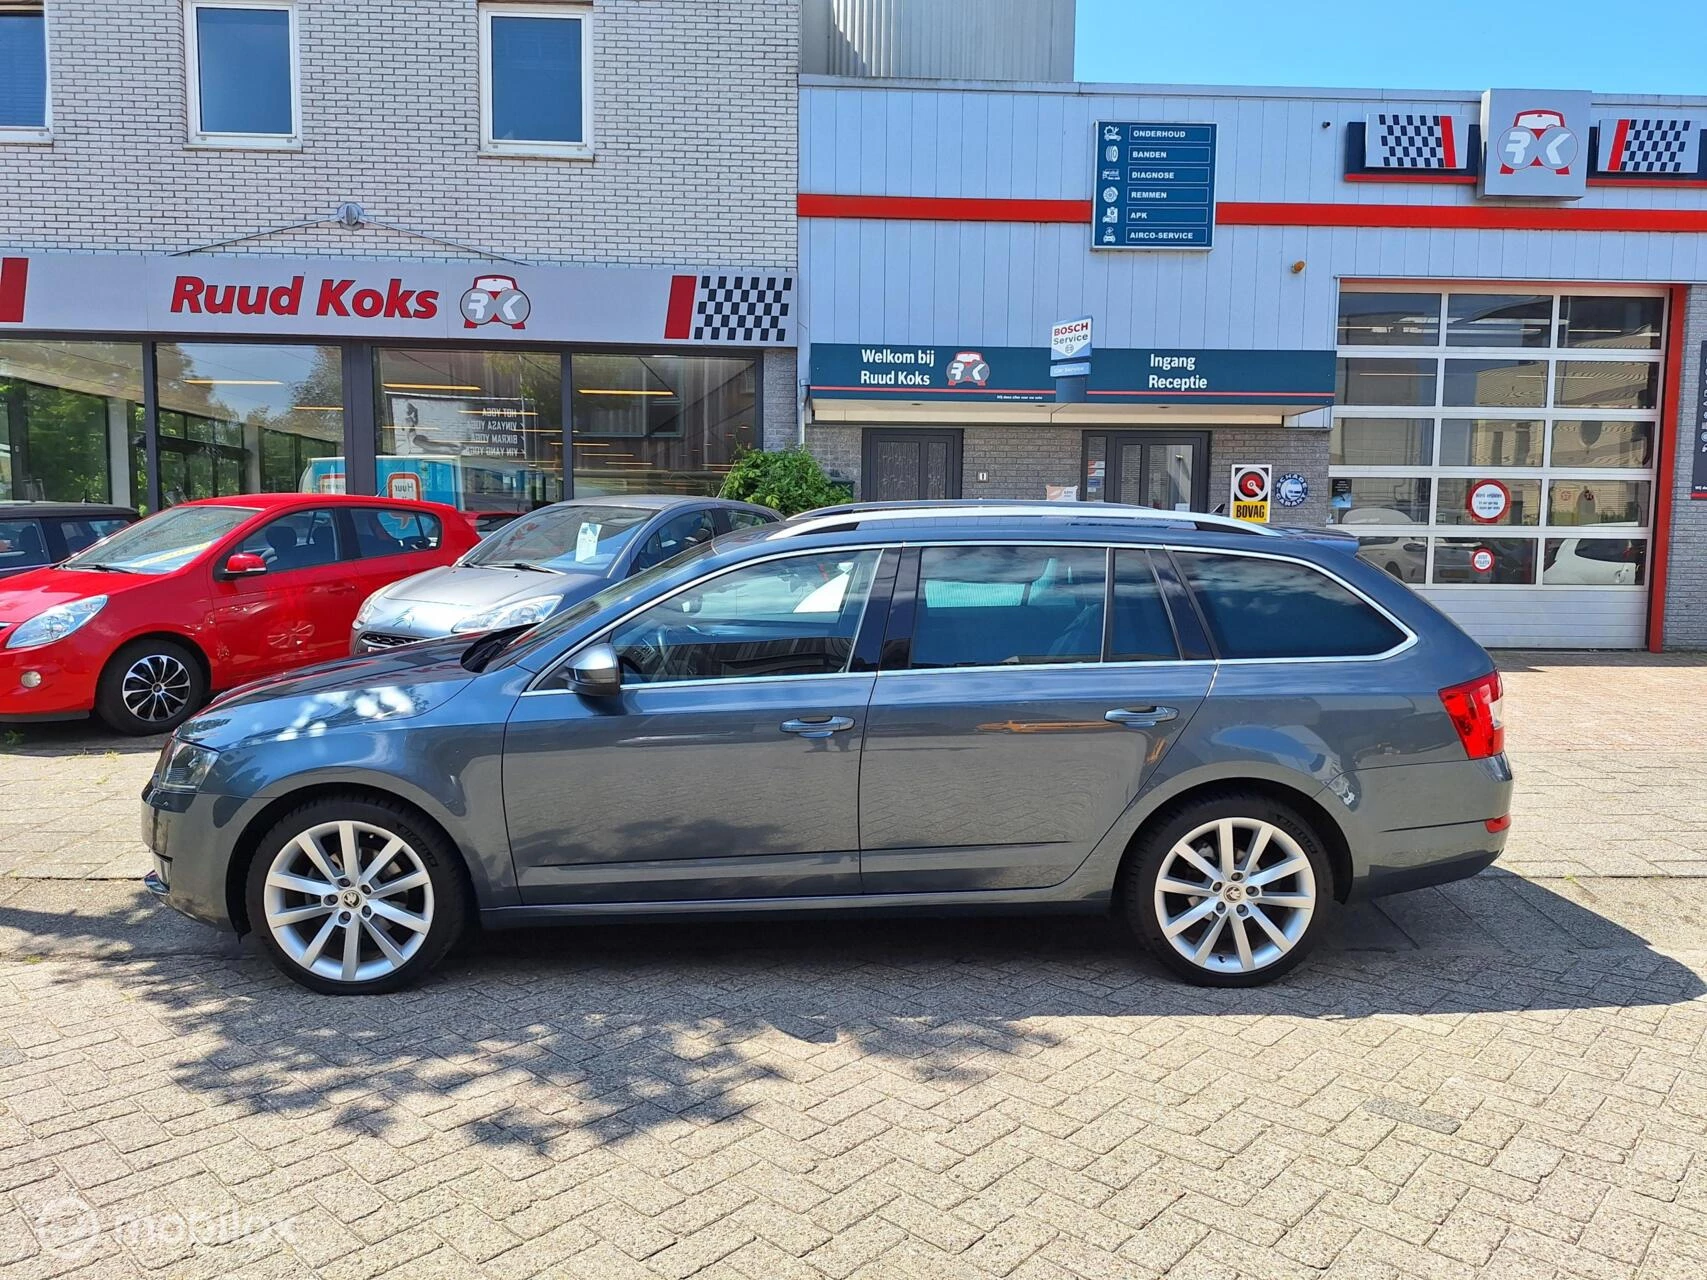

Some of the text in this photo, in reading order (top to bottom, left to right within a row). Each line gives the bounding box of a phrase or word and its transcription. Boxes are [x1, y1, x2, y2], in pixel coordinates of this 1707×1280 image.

[1133, 130, 1186, 138] ONDERHOUD
[1131, 171, 1175, 179] DIAGNOSE
[1131, 191, 1167, 199] REMMEN
[1129, 232, 1194, 240] AIRCO-SERVICE
[170, 275, 440, 320] Ruud Koks
[1053, 321, 1089, 337] BOSCH
[1053, 333, 1089, 346] Service
[861, 349, 935, 367] Welkom bij
[1150, 353, 1196, 371] Ingang
[860, 370, 931, 385] Ruud Koks
[1148, 374, 1208, 391] Receptie
[1276, 473, 1308, 488] SCHADE
[1236, 504, 1265, 519] BOVAG
